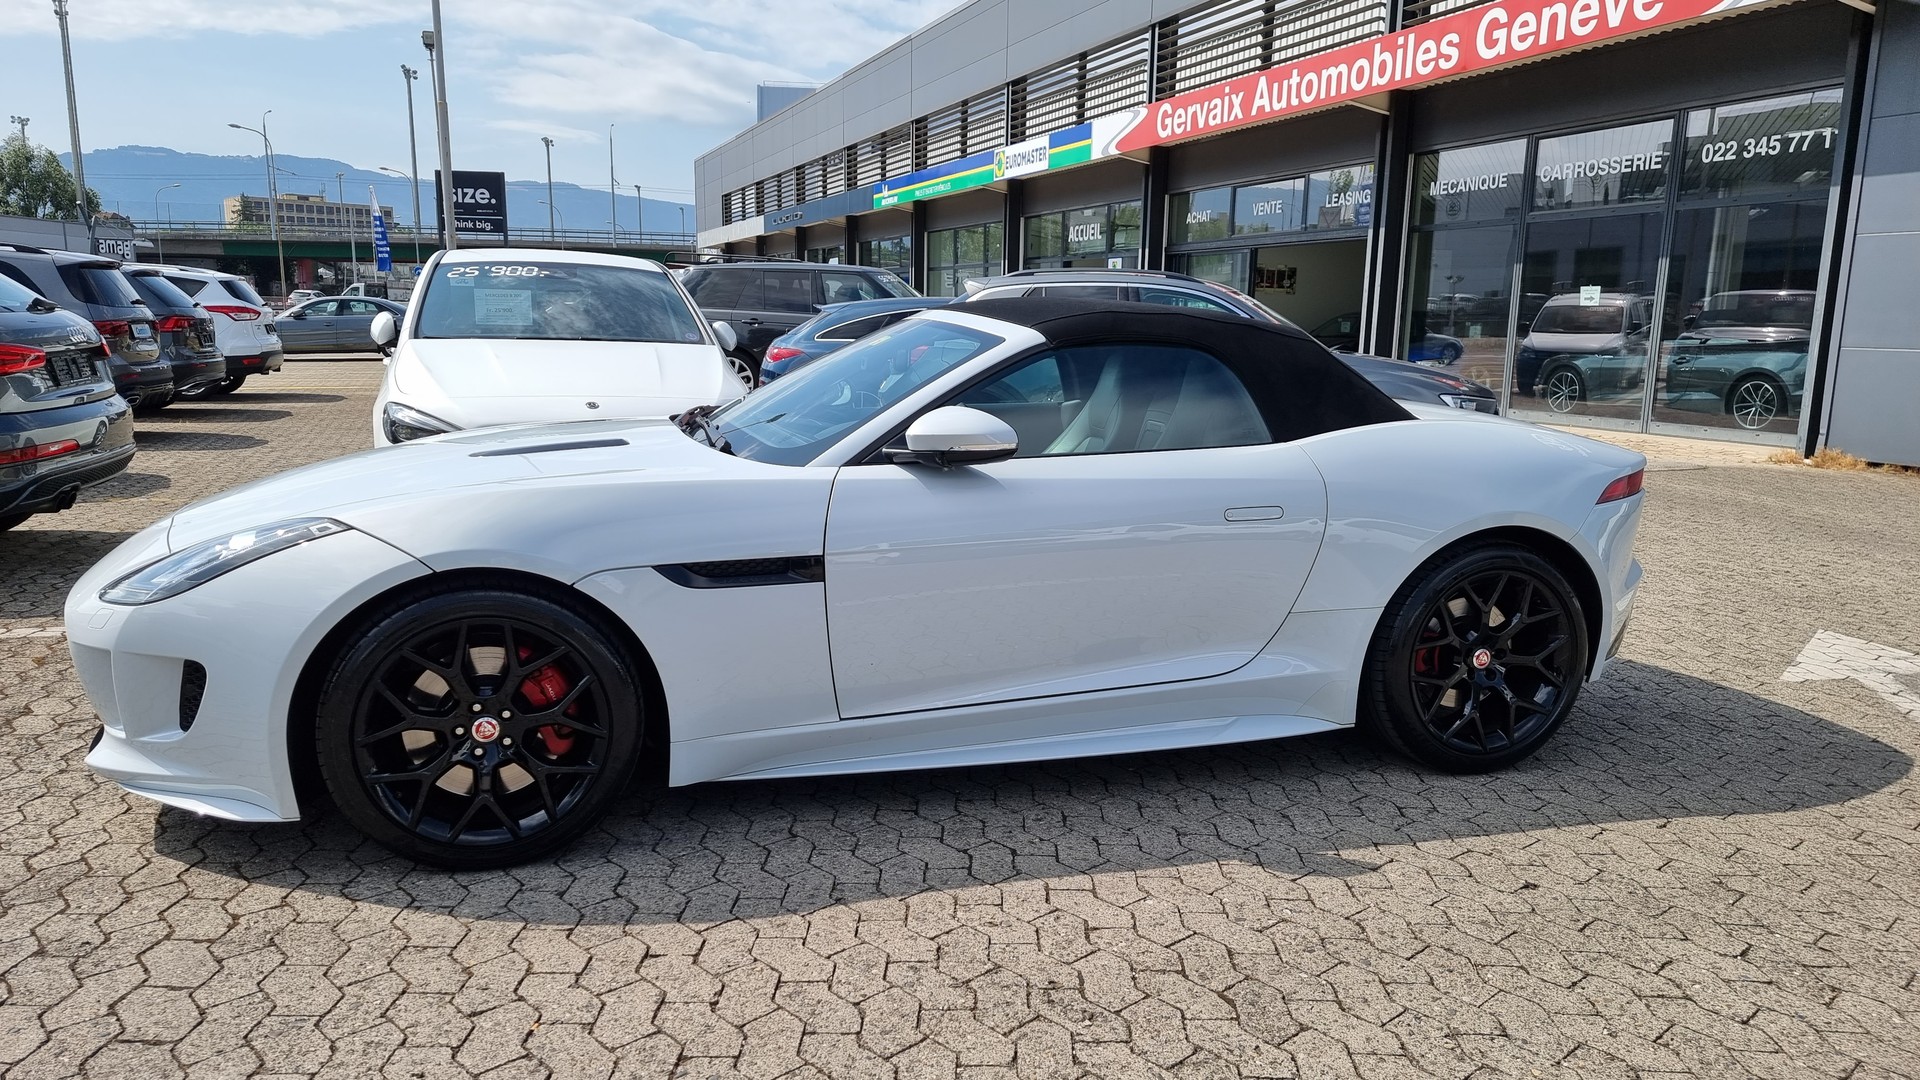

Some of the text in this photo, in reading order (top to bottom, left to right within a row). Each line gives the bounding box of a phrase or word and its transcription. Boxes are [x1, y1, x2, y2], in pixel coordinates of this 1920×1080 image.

[1156, 86, 1244, 139] Gervaix
[1250, 32, 1460, 117] Automobiles
[1005, 146, 1047, 170] EUROMASTER
[1701, 140, 1738, 164] 022
[1742, 134, 1782, 159] 345
[1788, 131, 1815, 153] 77
[1540, 151, 1663, 183] CARROSSERIE
[1429, 172, 1508, 196] MECANIQUE
[1252, 200, 1283, 216] VENTE
[1325, 189, 1371, 208] LEASING
[455, 220, 493, 230] hink big.
[1186, 209, 1212, 224] ACHAT
[1068, 223, 1102, 242] ACCUEIL
[98, 239, 131, 260] amag
